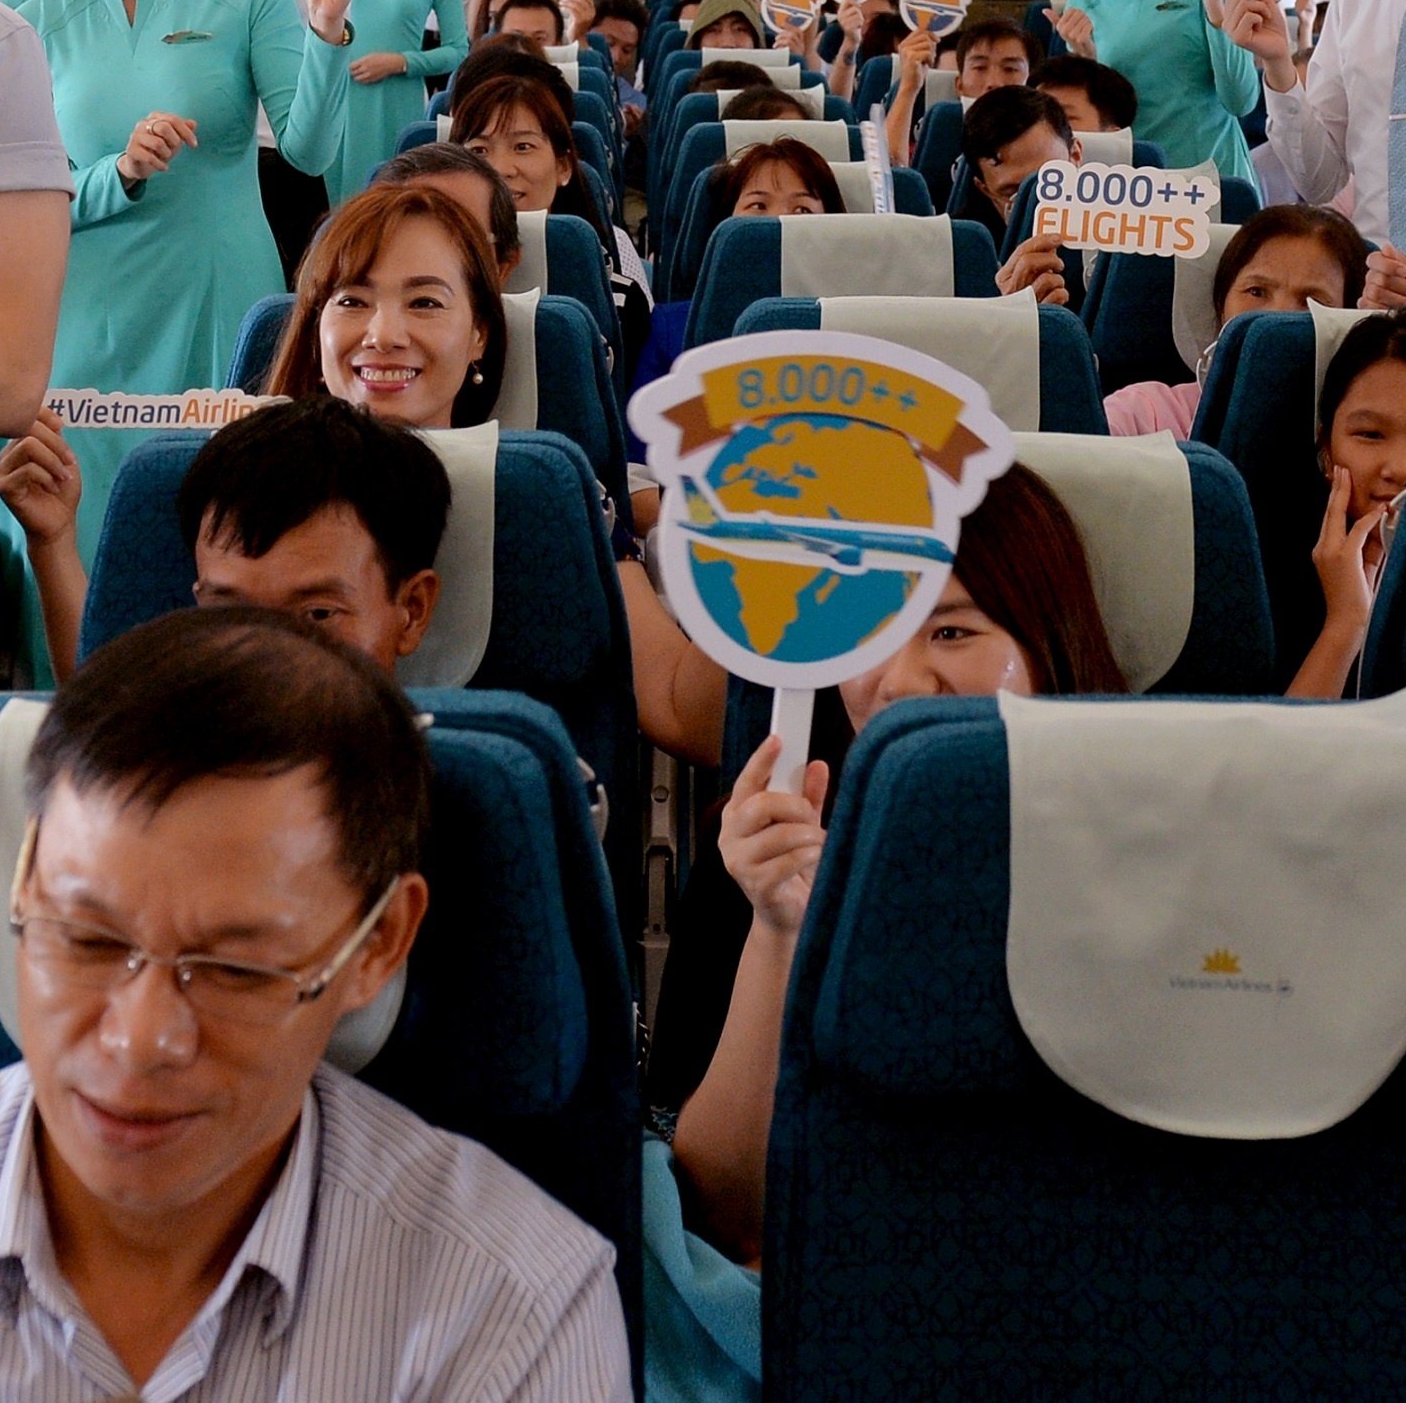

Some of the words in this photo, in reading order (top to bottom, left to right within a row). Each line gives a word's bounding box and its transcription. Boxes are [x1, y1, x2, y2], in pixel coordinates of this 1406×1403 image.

[1040, 168, 1205, 208] 8.000++
[1036, 207, 1196, 251] FLIGHTS
[738, 363, 918, 414] 8.000++
[47, 398, 255, 425] #VietnamAirlin
